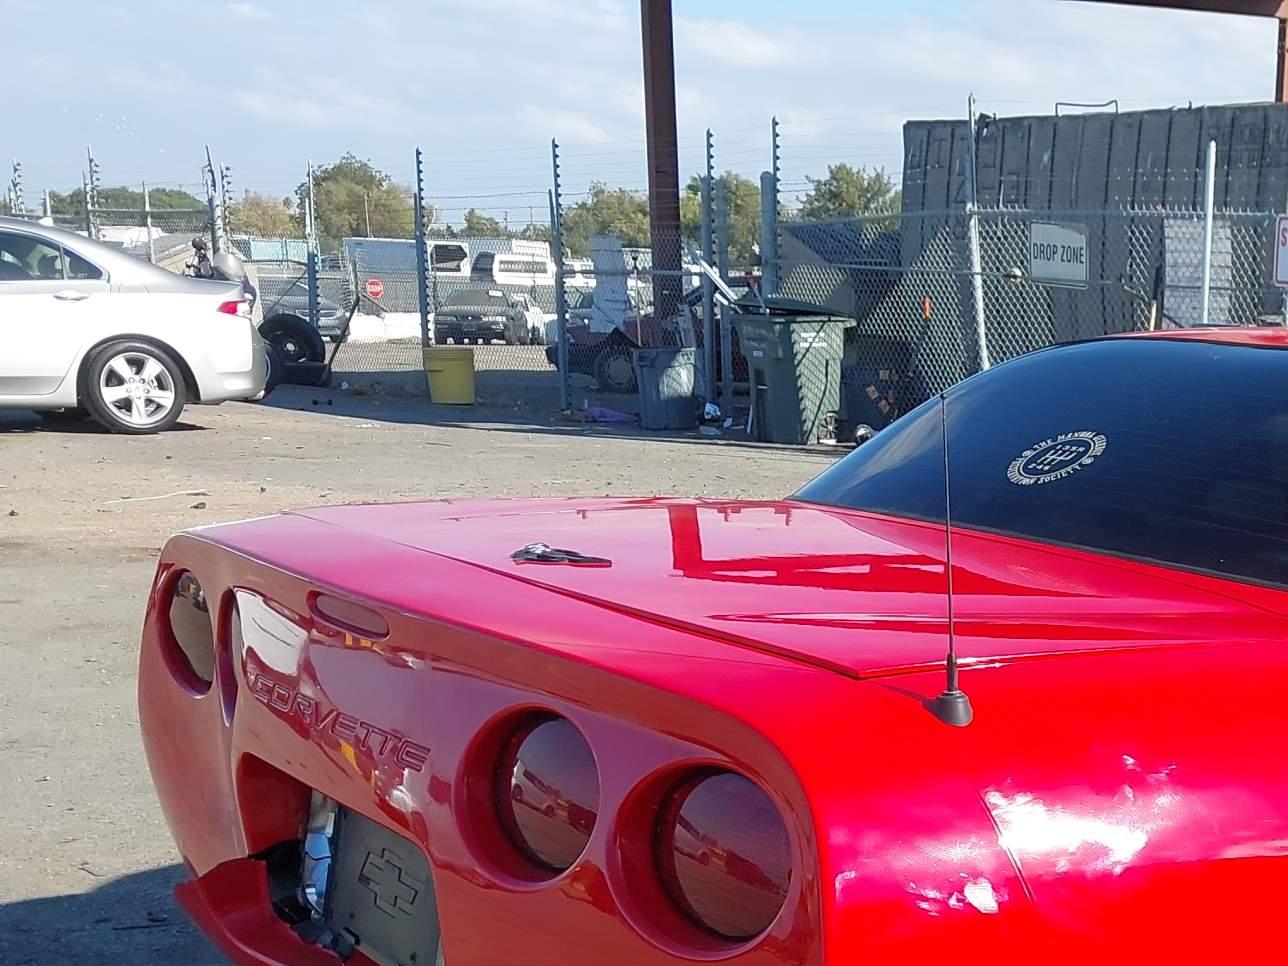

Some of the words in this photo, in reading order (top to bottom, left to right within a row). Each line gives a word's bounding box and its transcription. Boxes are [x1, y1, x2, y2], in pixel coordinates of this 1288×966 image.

[1032, 243, 1058, 261] DROP
[1060, 245, 1084, 264] ZONE
[253, 673, 432, 772] CORVETTE
